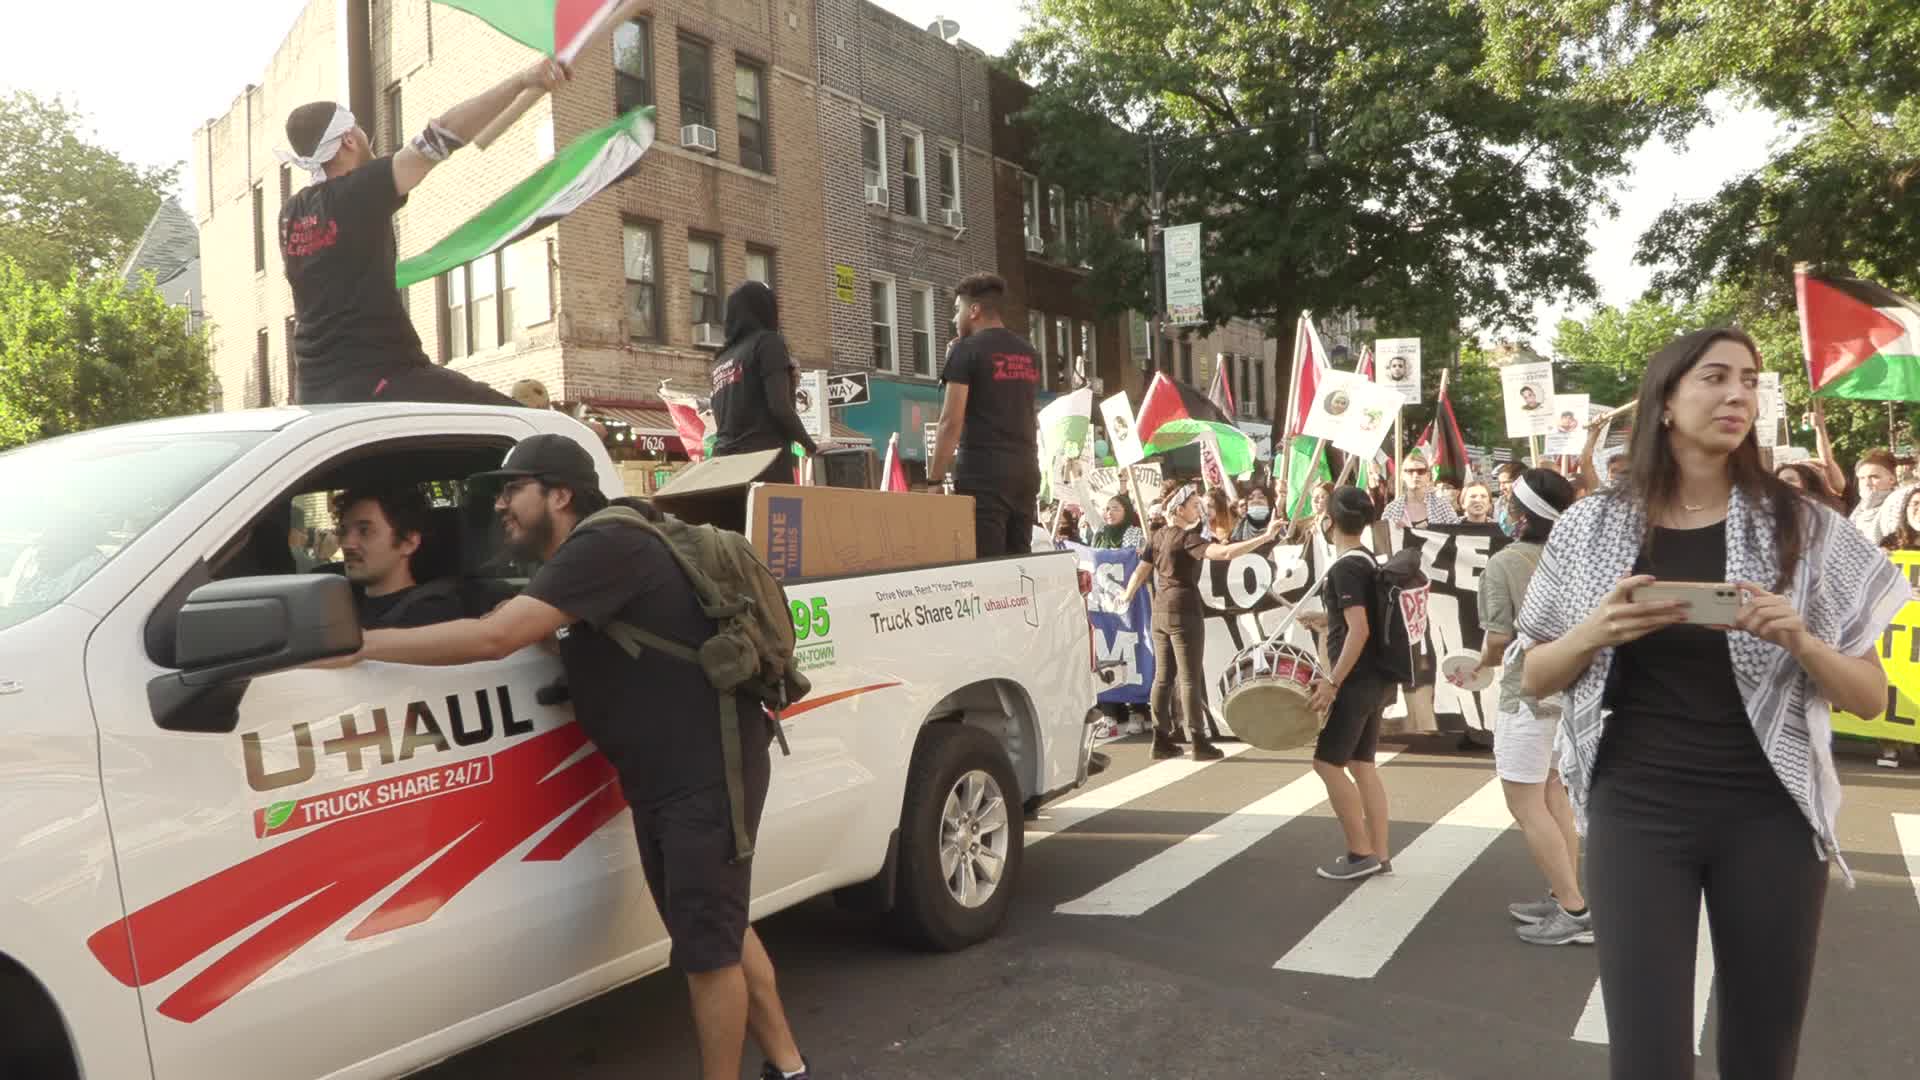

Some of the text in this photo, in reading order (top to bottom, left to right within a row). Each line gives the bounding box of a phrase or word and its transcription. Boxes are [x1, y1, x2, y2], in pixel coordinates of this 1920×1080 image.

[829, 383, 854, 397] WAY
[640, 436, 665, 450] 7626
[876, 590, 896, 602] Drive
[914, 585, 931, 596] Rent
[952, 579, 974, 590] Phone
[870, 592, 1029, 634] Truck Share 24/7 uhaul.com
[302, 762, 482, 824] TRUCK SHARE 24/7
